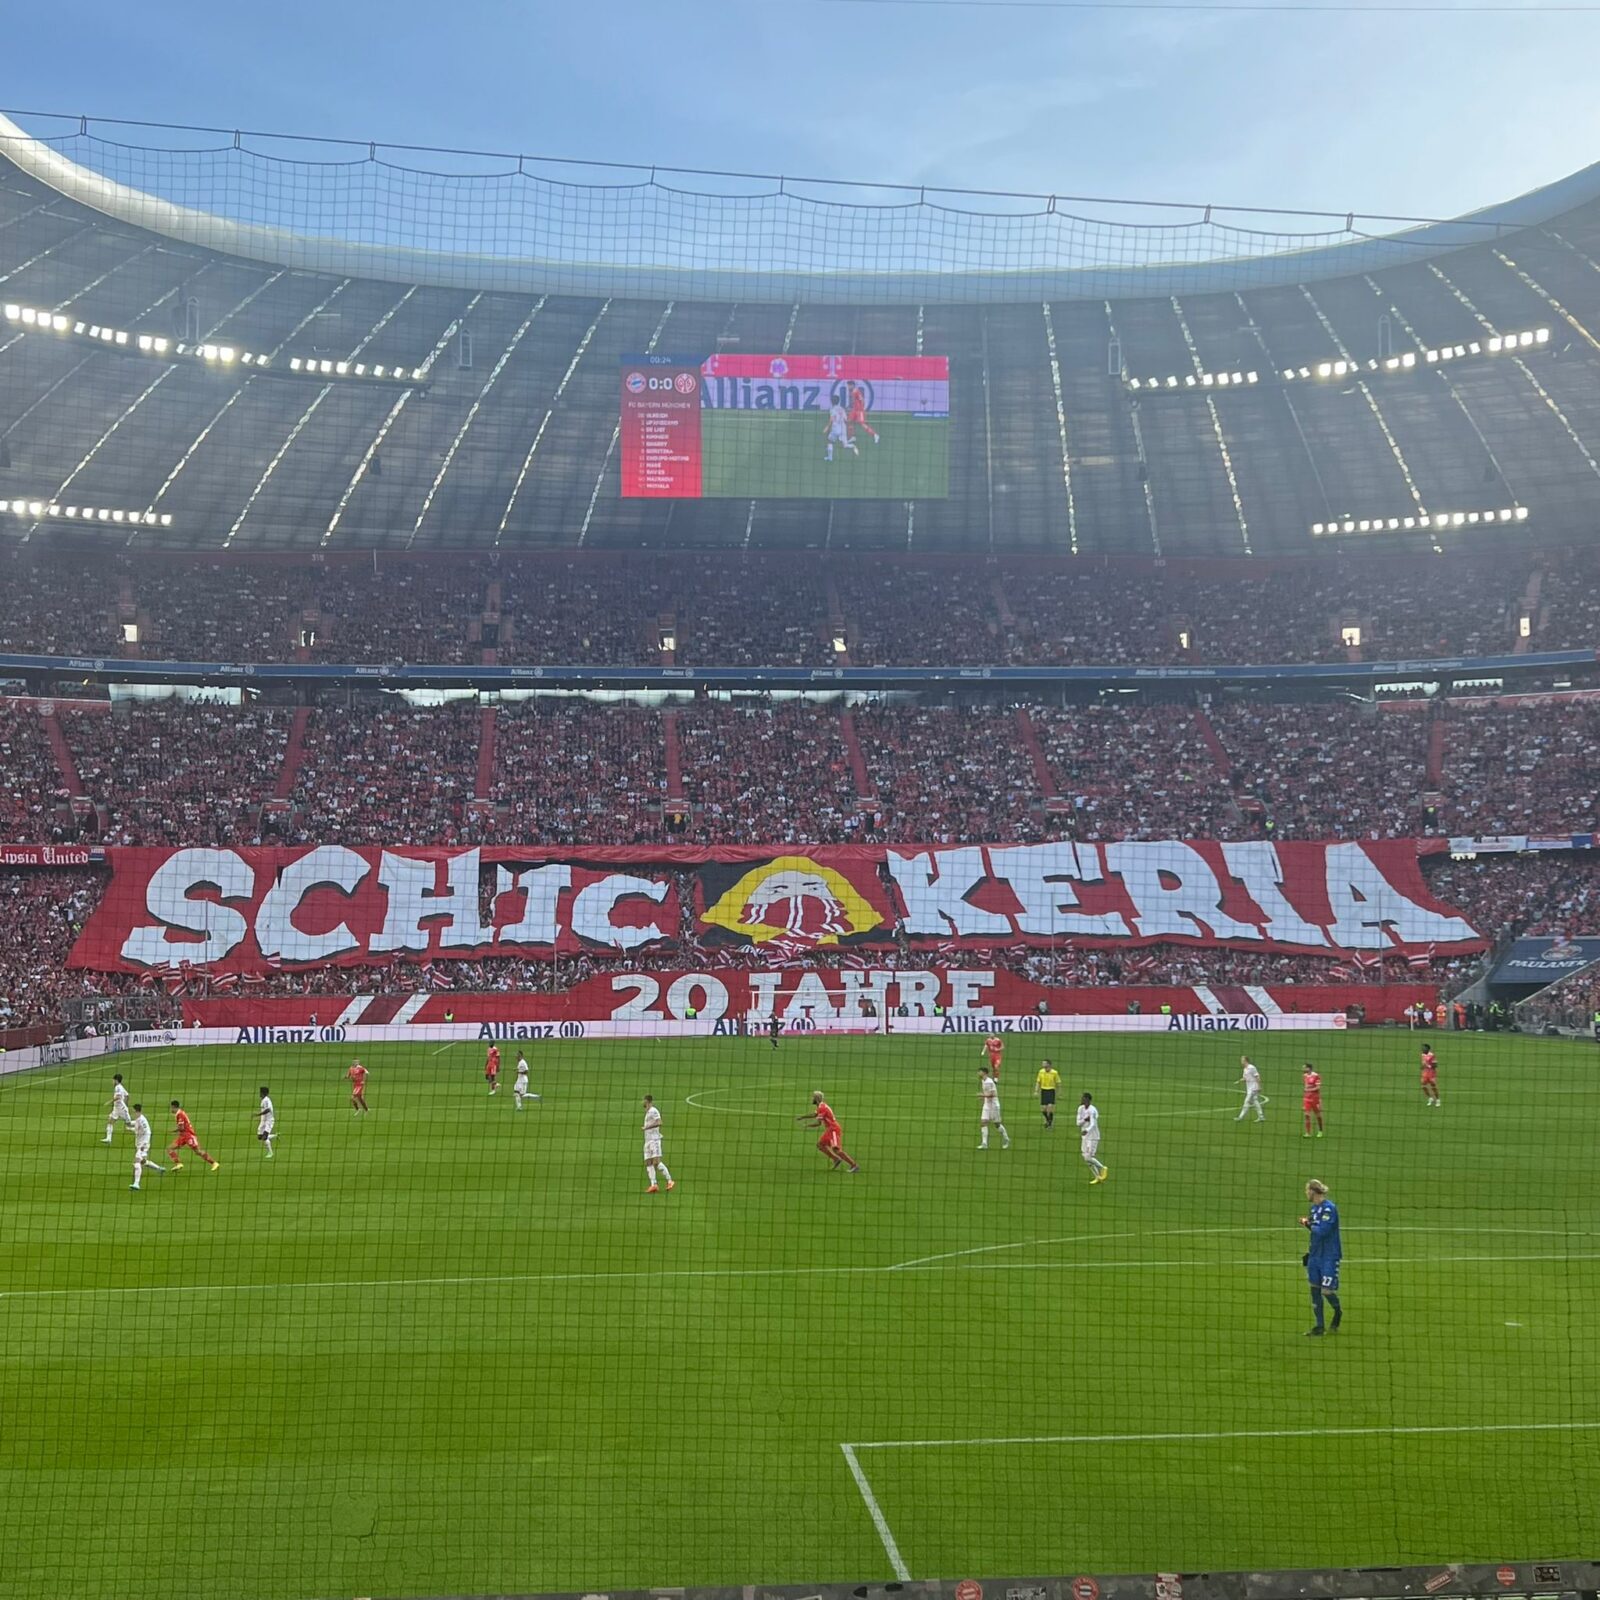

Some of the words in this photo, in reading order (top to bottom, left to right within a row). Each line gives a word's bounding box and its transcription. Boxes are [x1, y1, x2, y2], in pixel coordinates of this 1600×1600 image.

[648, 378, 673, 390] 0:0
[68, 660, 94, 668] Allianz
[511, 668, 533, 676] Allianz
[960, 669, 981, 677] Allianz
[42, 846, 89, 864] United
[120, 845, 670, 968] SCHIC
[887, 840, 1481, 949] KERIA
[1507, 960, 1588, 969] PAULANER
[611, 973, 729, 1021] 20
[748, 970, 995, 1020] JAHRE
[478, 1021, 554, 1040] Allianz
[941, 1016, 1014, 1033] Allianz
[1168, 1014, 1240, 1031] Allianz
[133, 1033, 162, 1044] Allianz
[236, 1025, 315, 1044] Allianz
